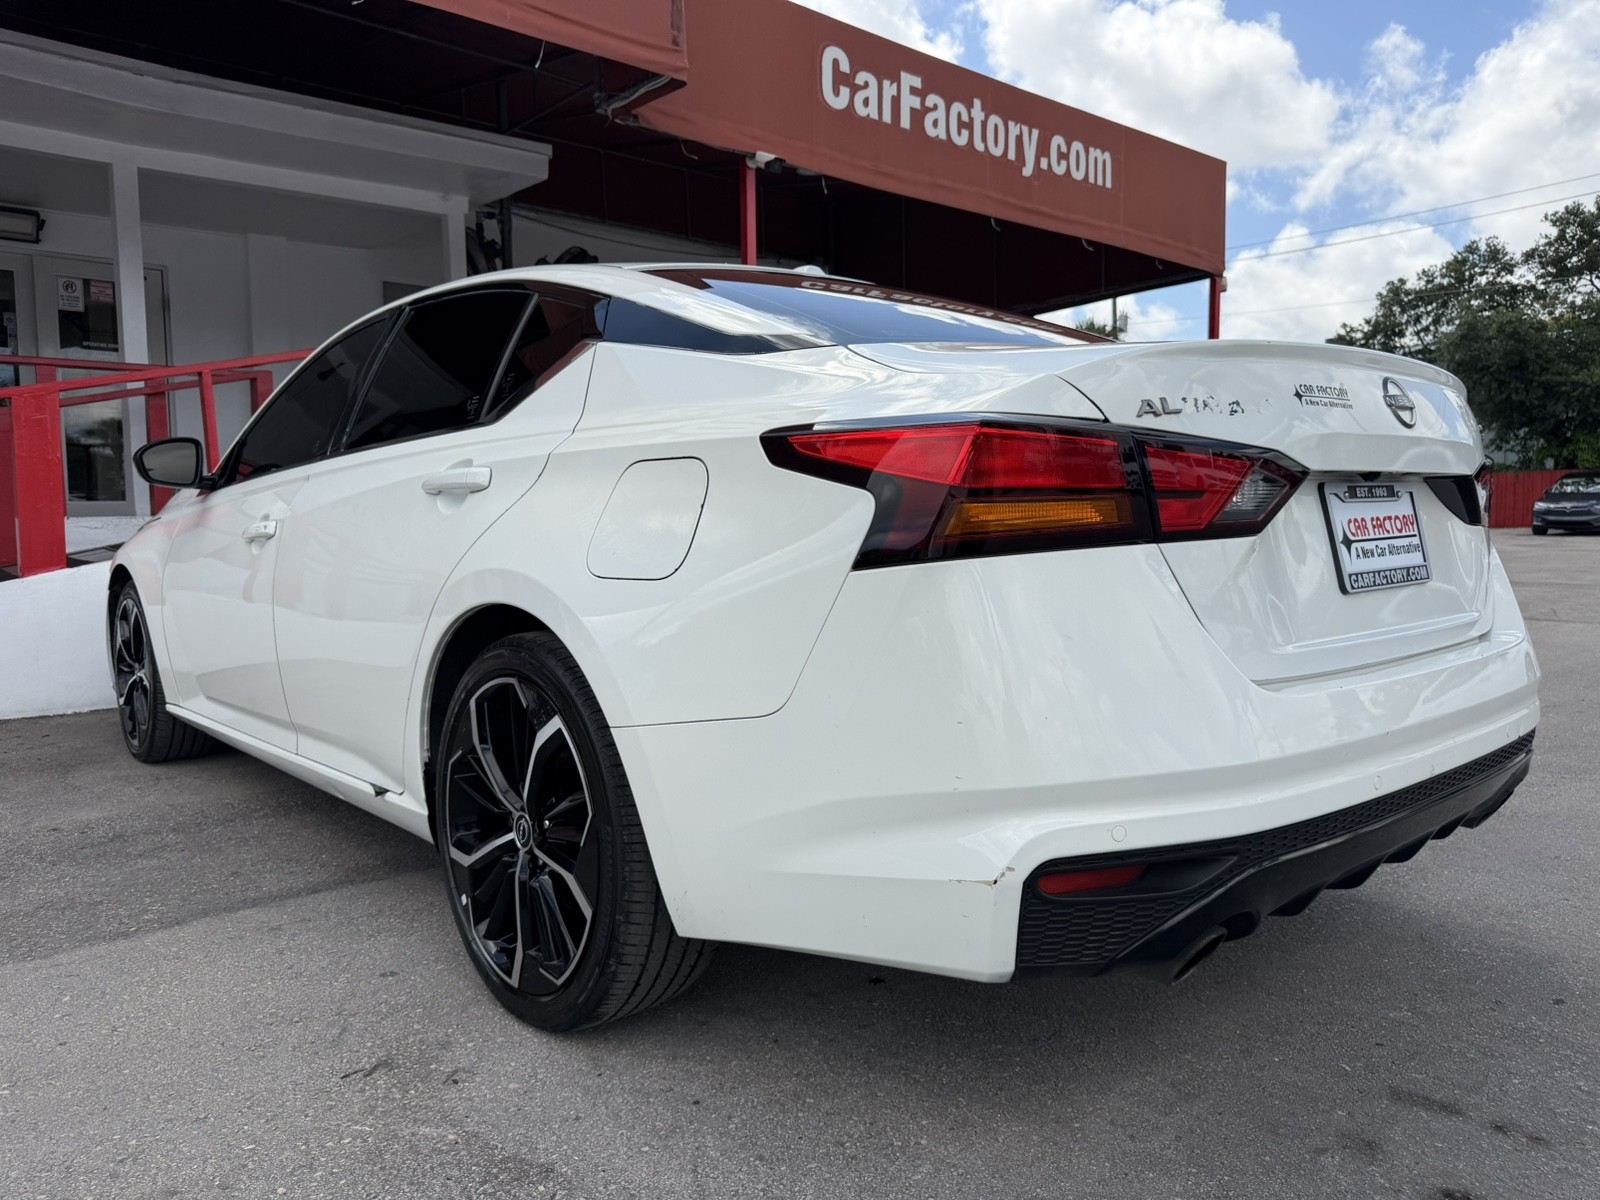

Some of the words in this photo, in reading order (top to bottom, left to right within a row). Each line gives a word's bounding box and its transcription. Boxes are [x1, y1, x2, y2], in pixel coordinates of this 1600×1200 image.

[821, 45, 1112, 188] CarFactory.com
[1299, 384, 1316, 394] CAR
[1316, 385, 1348, 398] FACTORY
[1304, 398, 1309, 406] A
[1356, 487, 1371, 497] EST.
[1347, 517, 1370, 538] CAR
[1370, 514, 1415, 536] FACTORY
[1355, 546, 1361, 560] A
[1361, 546, 1375, 559] New
[1375, 544, 1386, 558] Car
[1387, 541, 1421, 556] Alternative
[1350, 566, 1428, 588] CARFACTORY.COM
